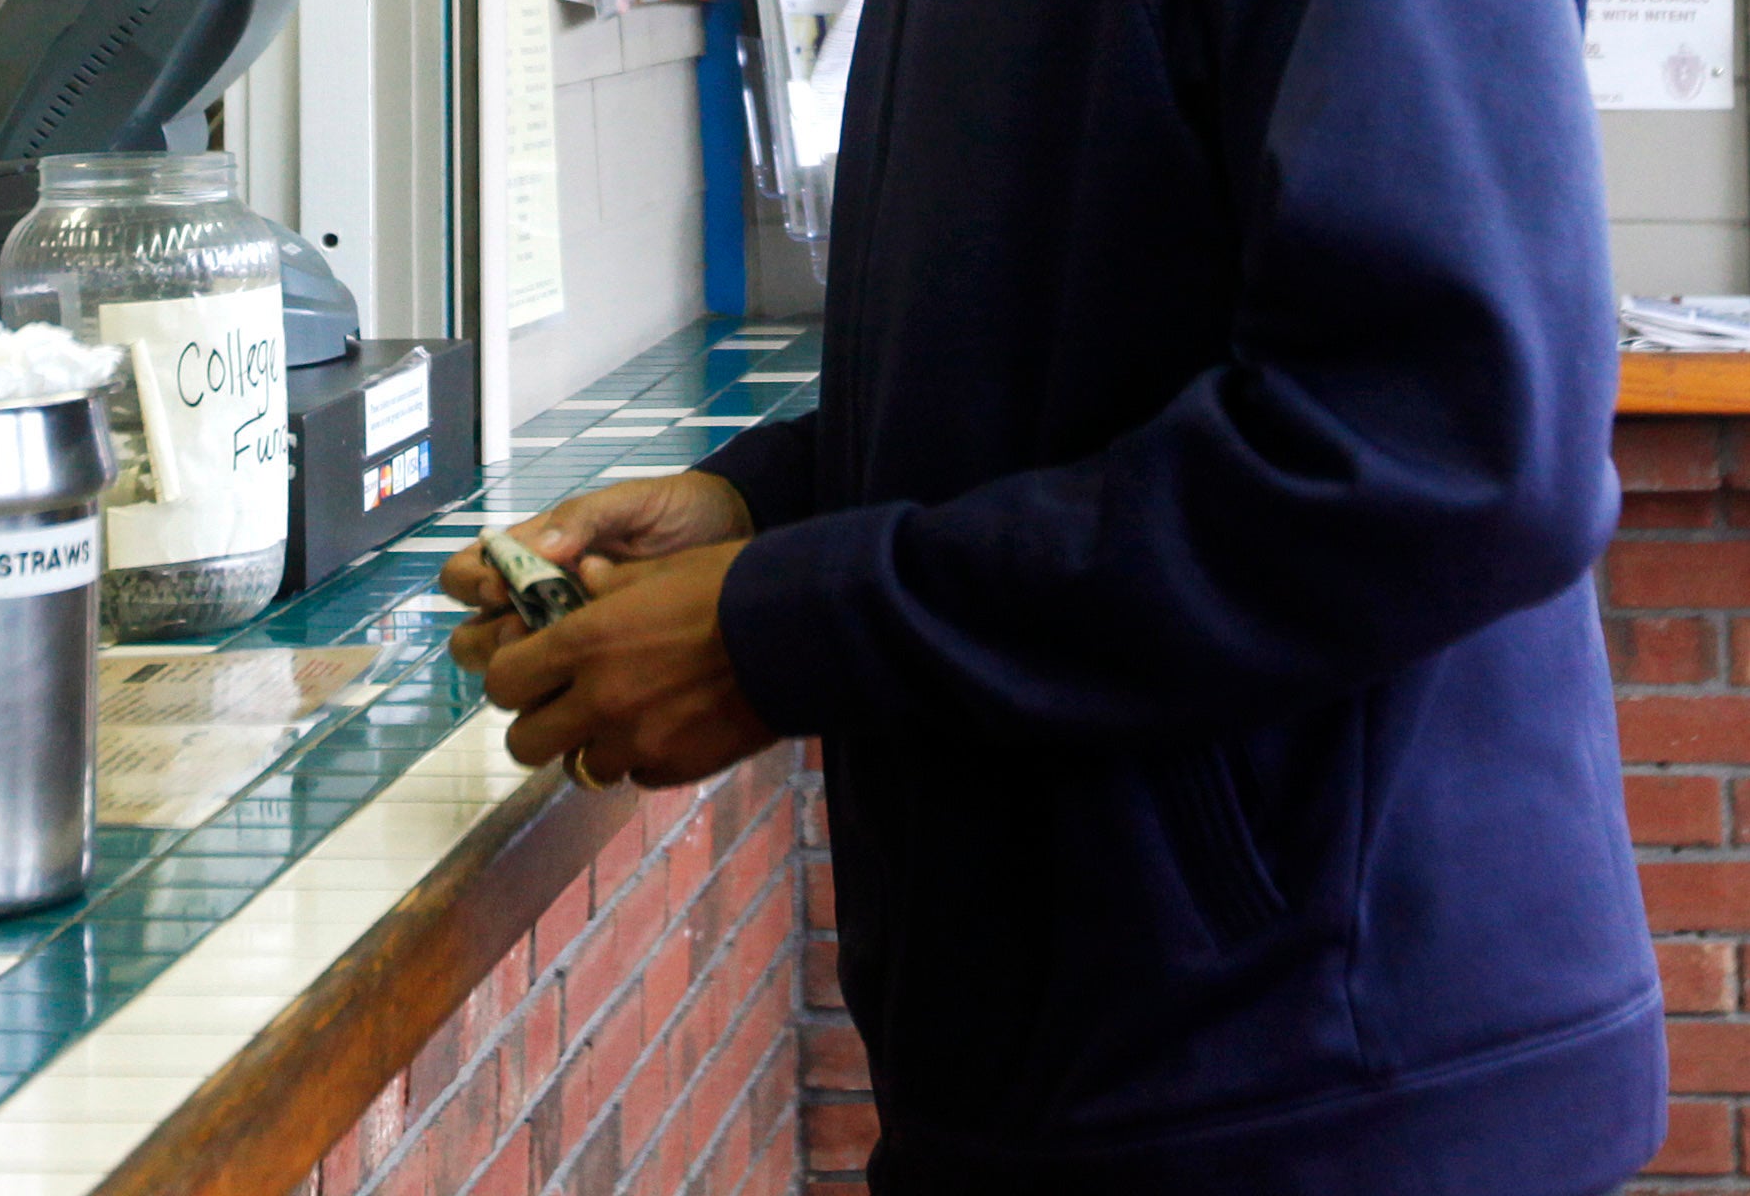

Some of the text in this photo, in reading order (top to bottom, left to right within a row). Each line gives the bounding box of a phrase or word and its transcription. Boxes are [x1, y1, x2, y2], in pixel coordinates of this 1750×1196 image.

[1602, 9, 1640, 22] WITH
[1644, 9, 1698, 23] INTENT
[176, 327, 280, 418] College
